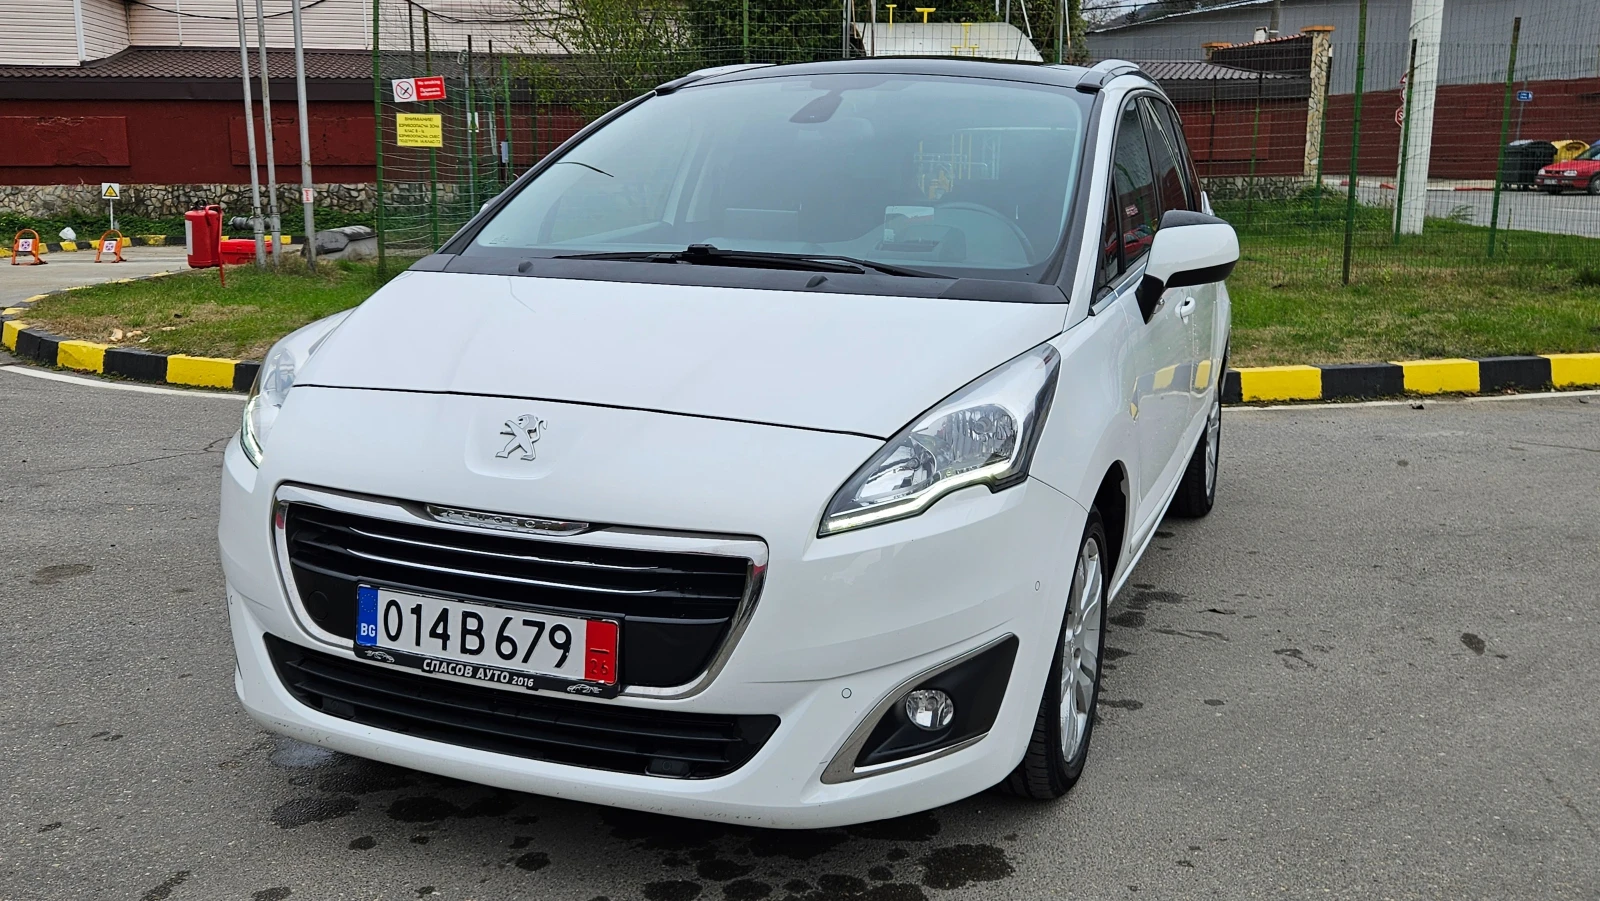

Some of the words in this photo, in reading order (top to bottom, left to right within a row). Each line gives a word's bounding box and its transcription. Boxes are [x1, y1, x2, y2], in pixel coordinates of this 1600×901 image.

[360, 623, 376, 637] BG
[423, 659, 473, 677] СПАСОВ
[475, 668, 509, 683] АУТО
[511, 676, 534, 687] 2016
